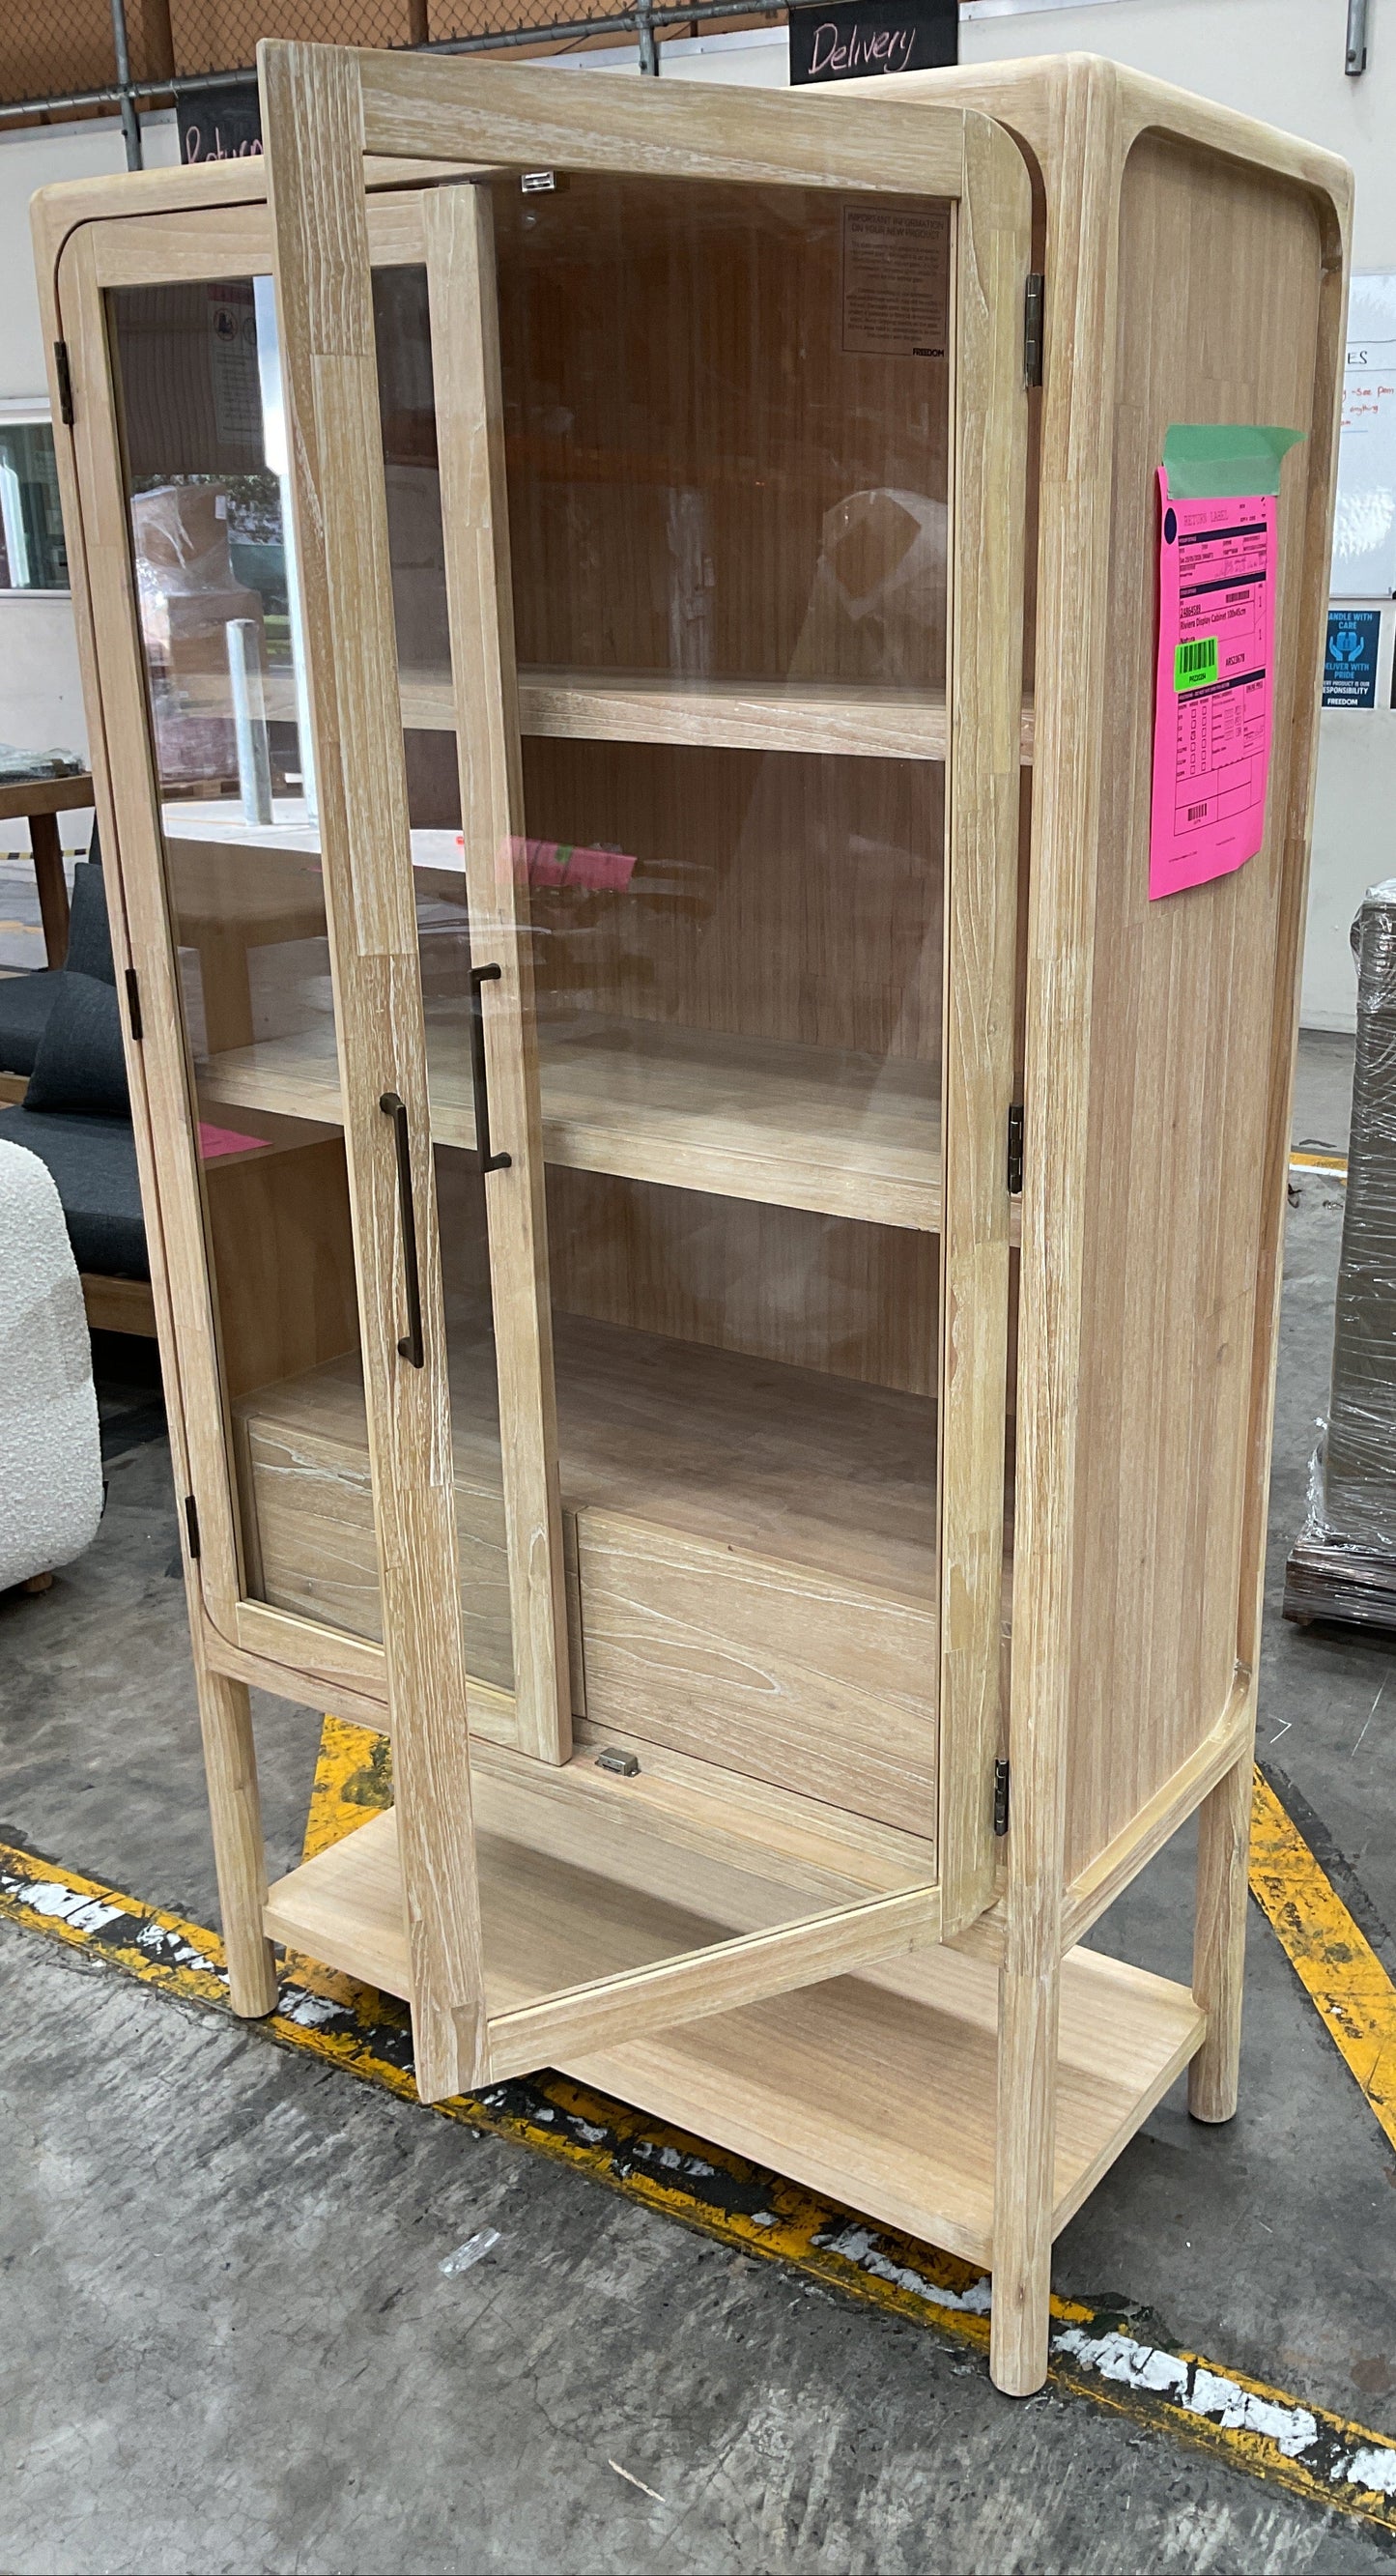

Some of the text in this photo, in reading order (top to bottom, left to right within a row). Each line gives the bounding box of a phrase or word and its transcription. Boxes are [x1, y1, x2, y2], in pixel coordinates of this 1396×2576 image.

[809, 23, 916, 74] Delivery
[185, 126, 263, 164] Rtrn
[912, 348, 944, 358] FREEDOM
[1180, 619, 1196, 630] Riviera
[1196, 616, 1211, 627] Display
[1211, 612, 1227, 623] Cabinet
[1338, 621, 1357, 630] CARE
[1325, 662, 1349, 671] ELIVER
[1323, 686, 1369, 695] ESPONSIBILITY
